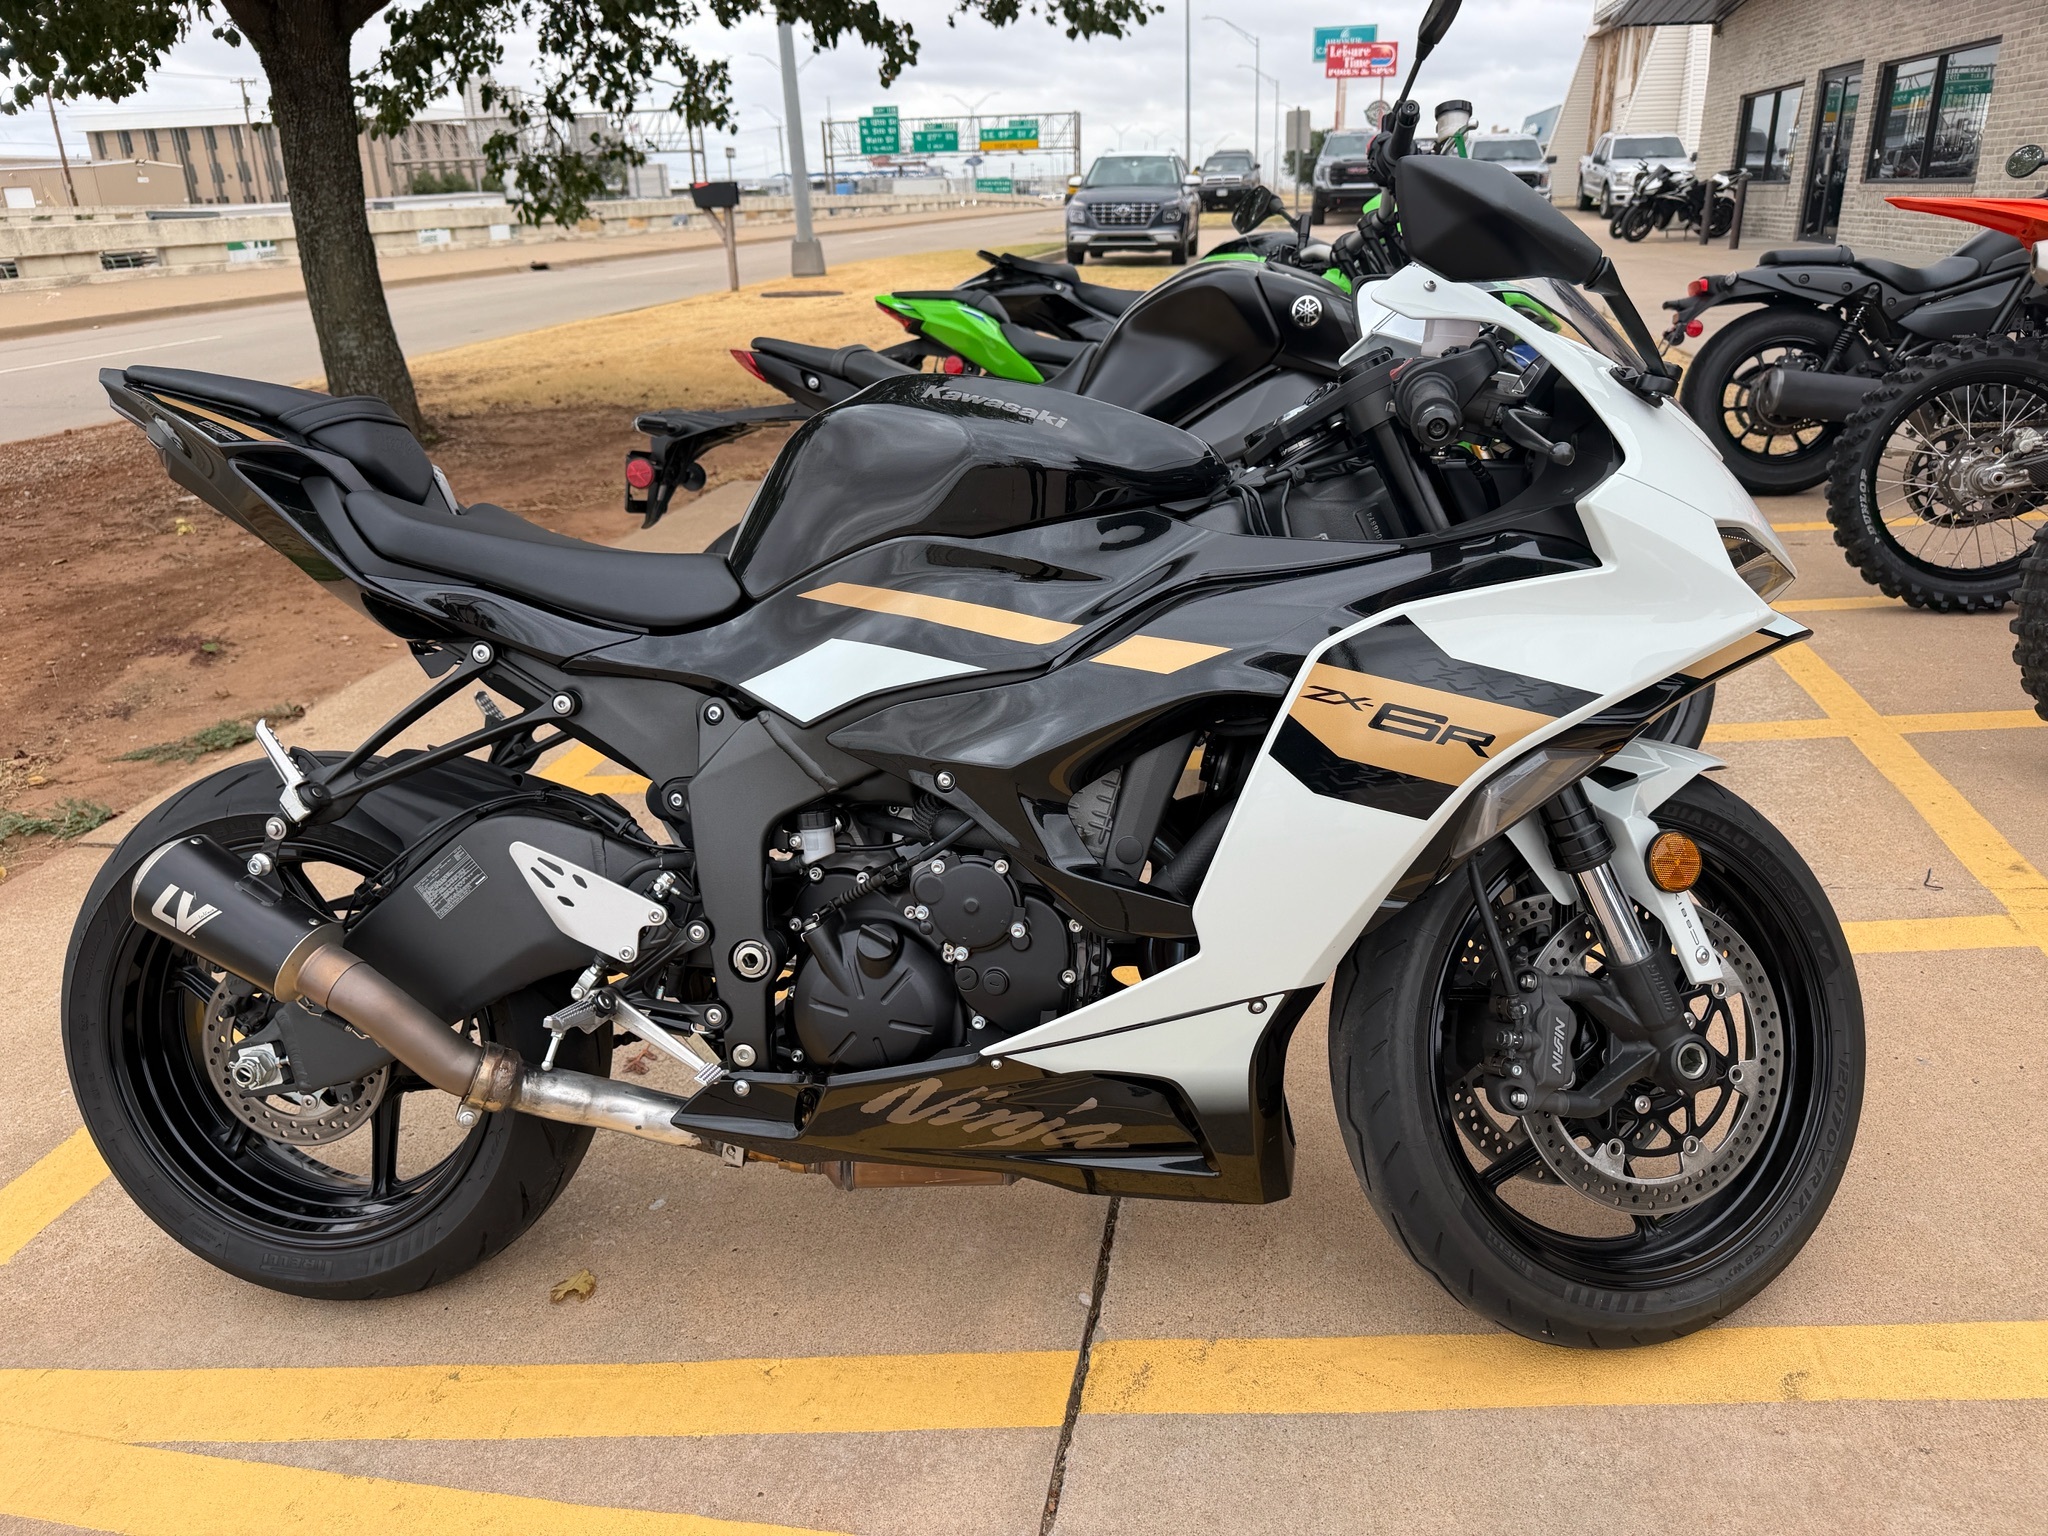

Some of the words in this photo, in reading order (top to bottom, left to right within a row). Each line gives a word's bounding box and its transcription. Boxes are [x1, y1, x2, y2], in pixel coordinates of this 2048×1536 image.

[1329, 45, 1371, 58] Leisure
[1344, 57, 1371, 68] Time
[920, 385, 1068, 429] Kawasaki
[1300, 685, 1496, 759] ZX-6R
[1662, 803, 1750, 849] DIABLO
[1751, 847, 1811, 917] ROSSO
[151, 883, 223, 936] LV
[1646, 963, 1677, 1011] SHOWA
[1551, 1016, 1566, 1075] NISSIN
[860, 1077, 1130, 1149] Ninja
[1826, 1058, 1850, 1148] 120/70
[259, 1253, 333, 1277] PIRELLI
